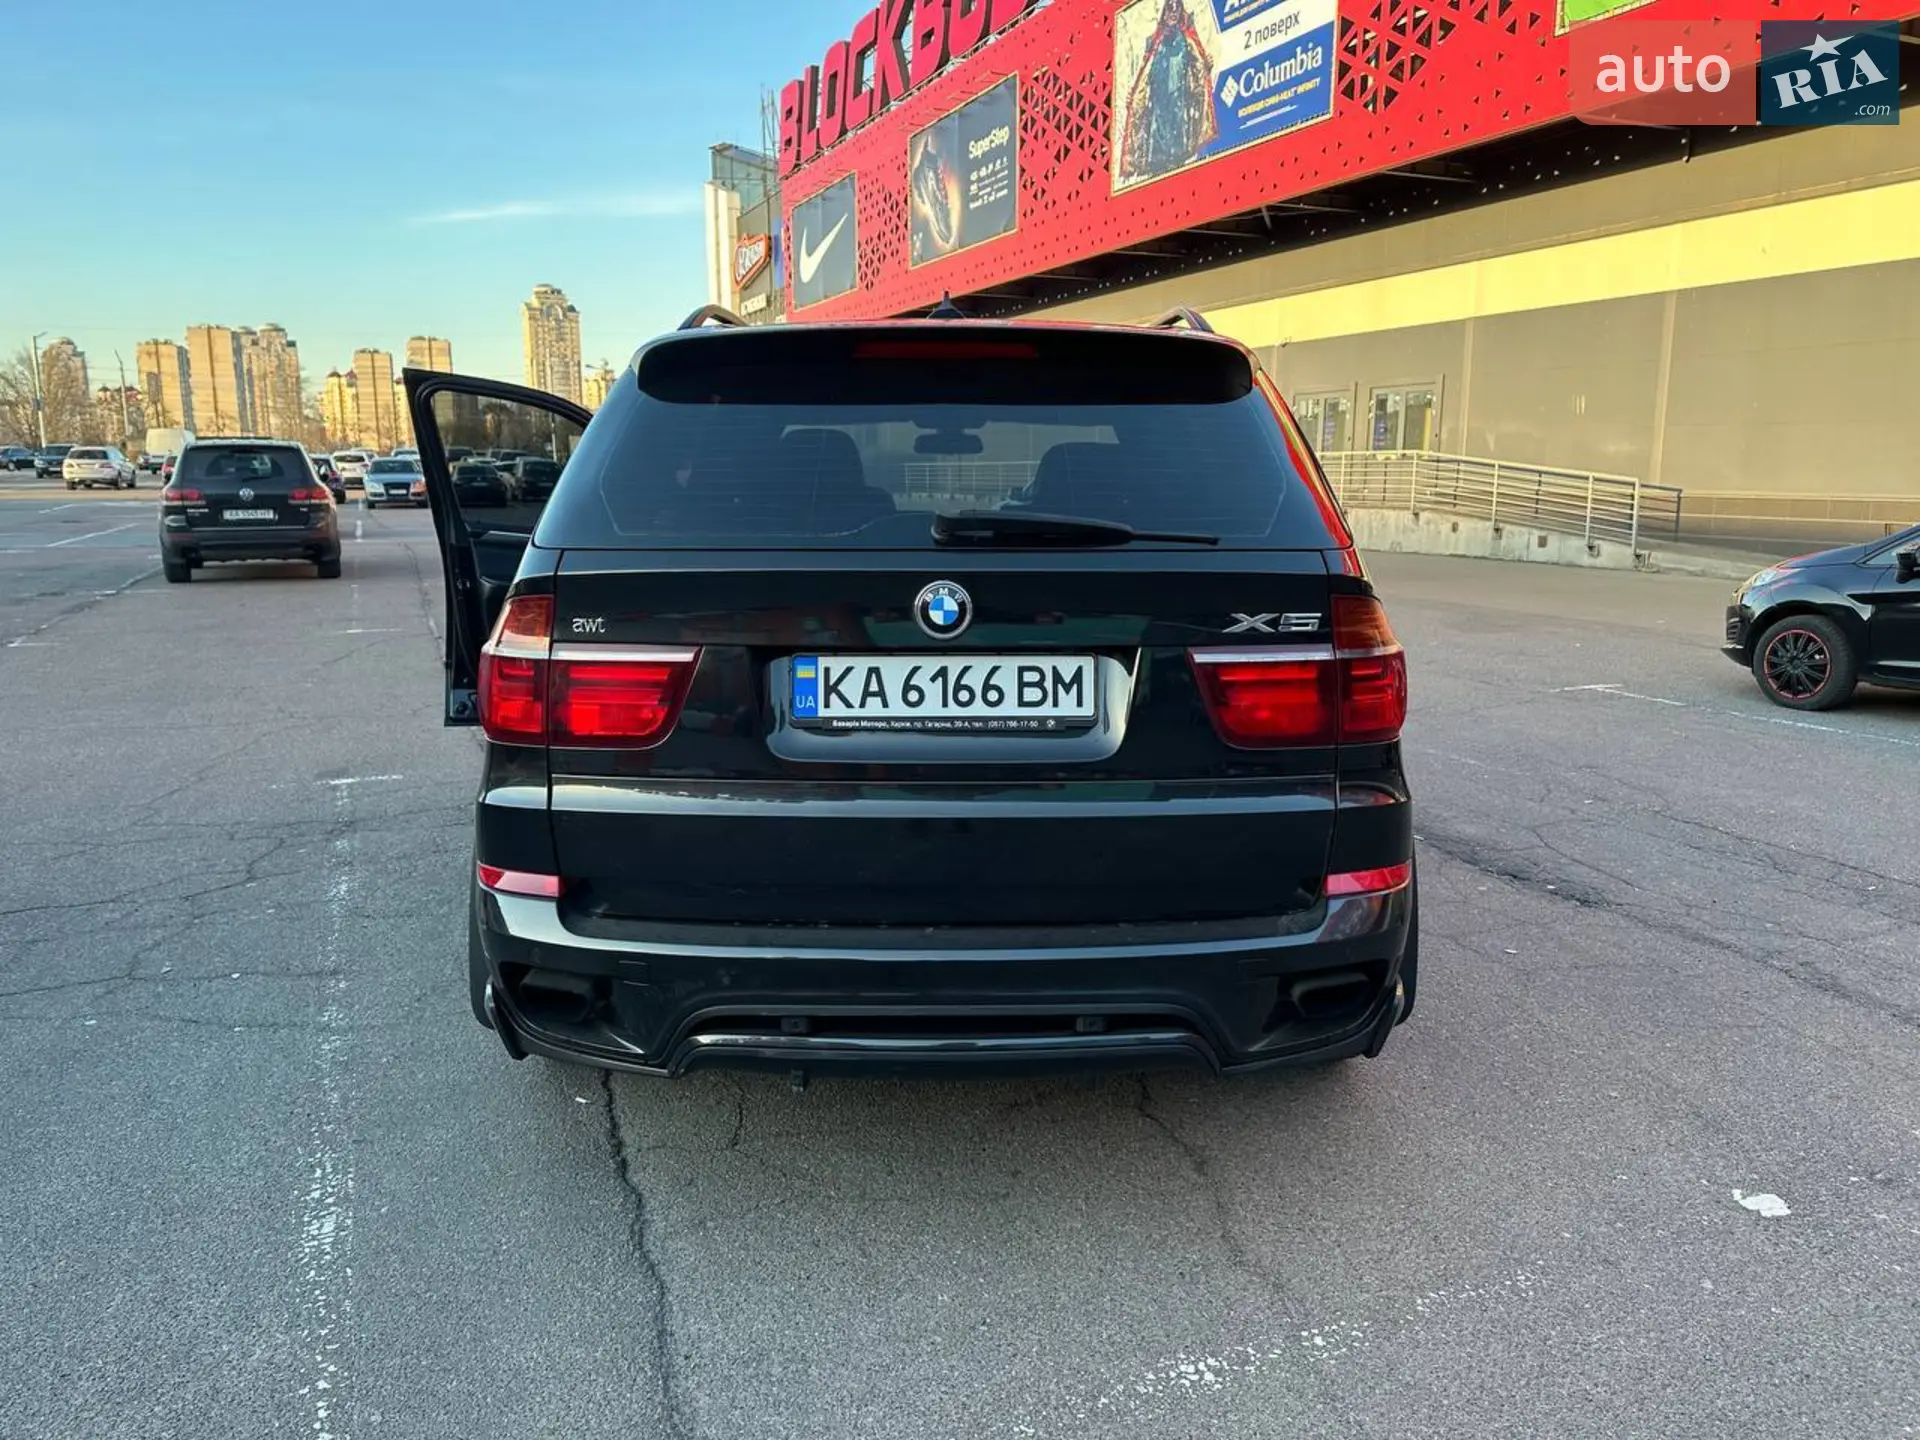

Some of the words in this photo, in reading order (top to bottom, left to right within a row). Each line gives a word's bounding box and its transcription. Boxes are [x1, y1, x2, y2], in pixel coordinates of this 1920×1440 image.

[1244, 30, 1252, 50] 2
[1255, 11, 1300, 45] поверх
[1239, 42, 1323, 98] Columbia
[969, 126, 1010, 159] SuperStep
[572, 617, 606, 633] awt
[1221, 612, 1323, 633] X5
[796, 696, 816, 709] UA
[822, 665, 889, 709] KA
[901, 665, 1005, 709] 6166
[1017, 665, 1084, 709] BM
